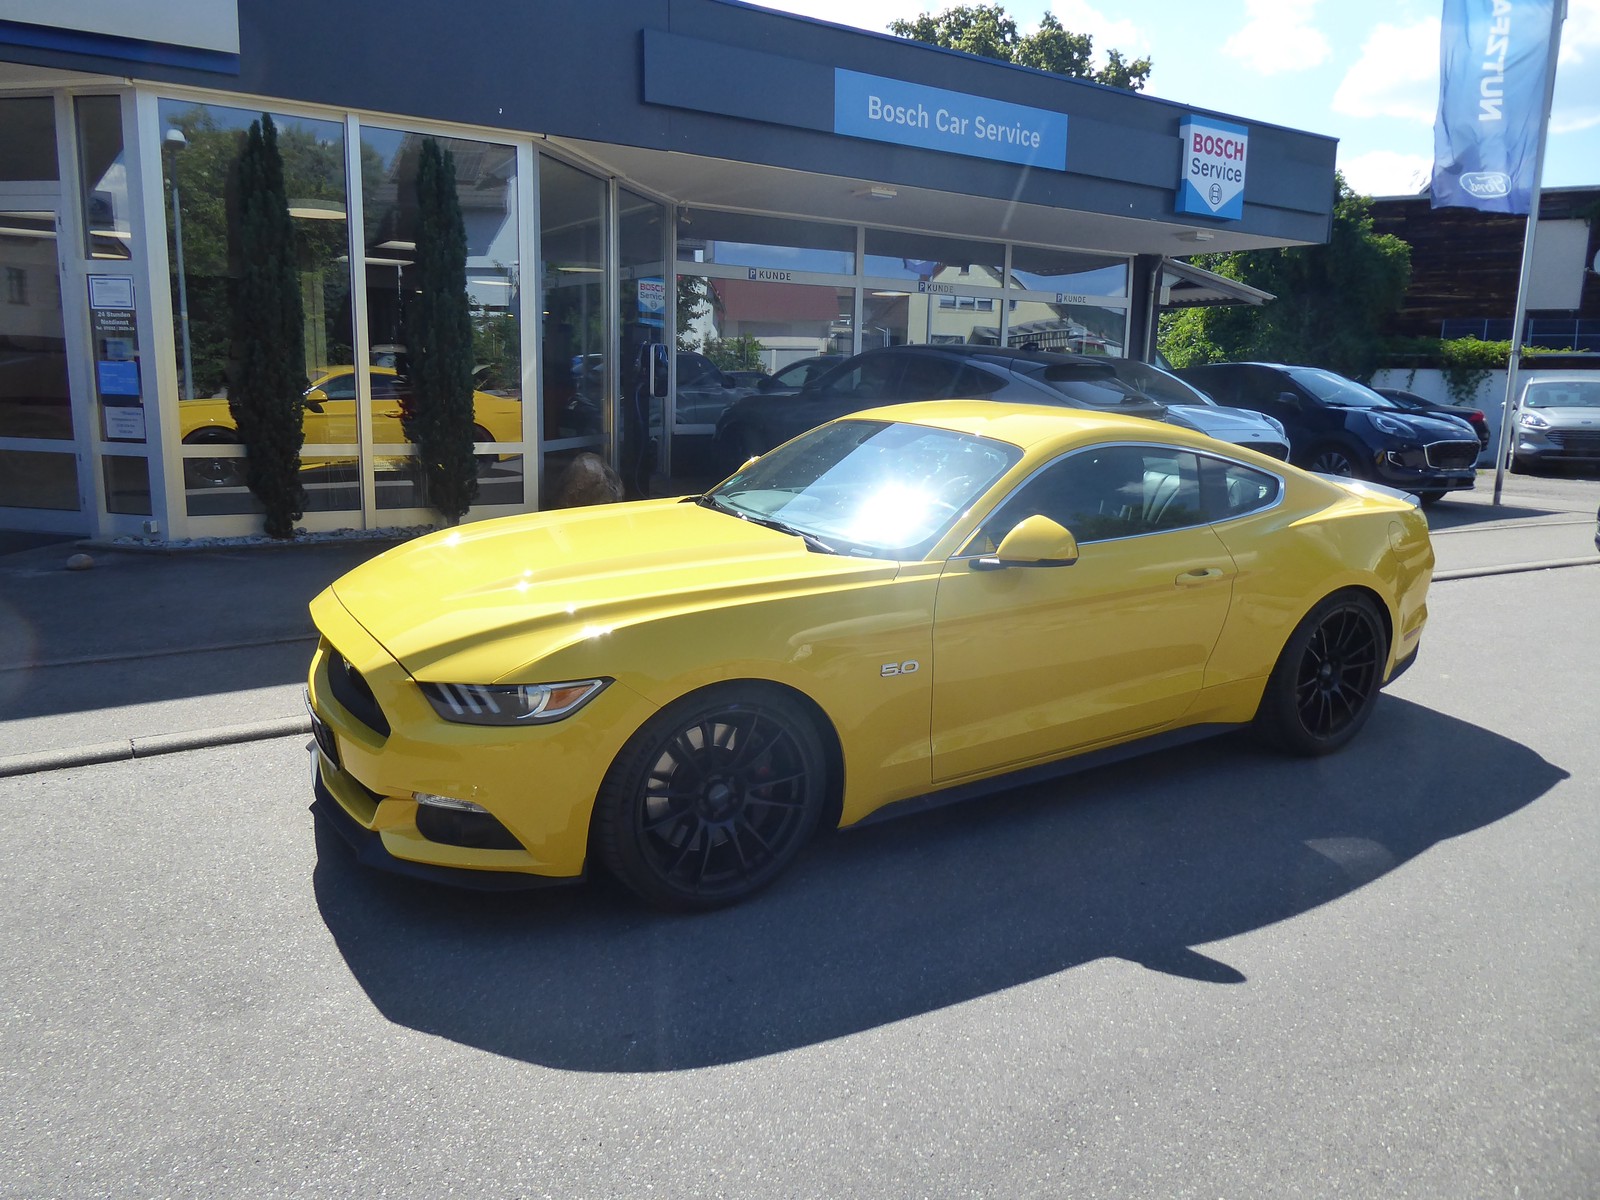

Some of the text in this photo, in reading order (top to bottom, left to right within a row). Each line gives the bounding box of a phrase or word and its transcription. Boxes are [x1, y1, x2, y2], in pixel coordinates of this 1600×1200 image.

[868, 95, 1041, 148] Bosch Car Service
[1193, 133, 1245, 161] BOSCH
[1191, 157, 1242, 183] Service
[759, 270, 792, 281] KUNDE
[640, 291, 665, 301] Servic
[927, 284, 954, 294] KUNDE
[1063, 295, 1087, 303] KUNDE
[880, 659, 919, 677] 5.0
